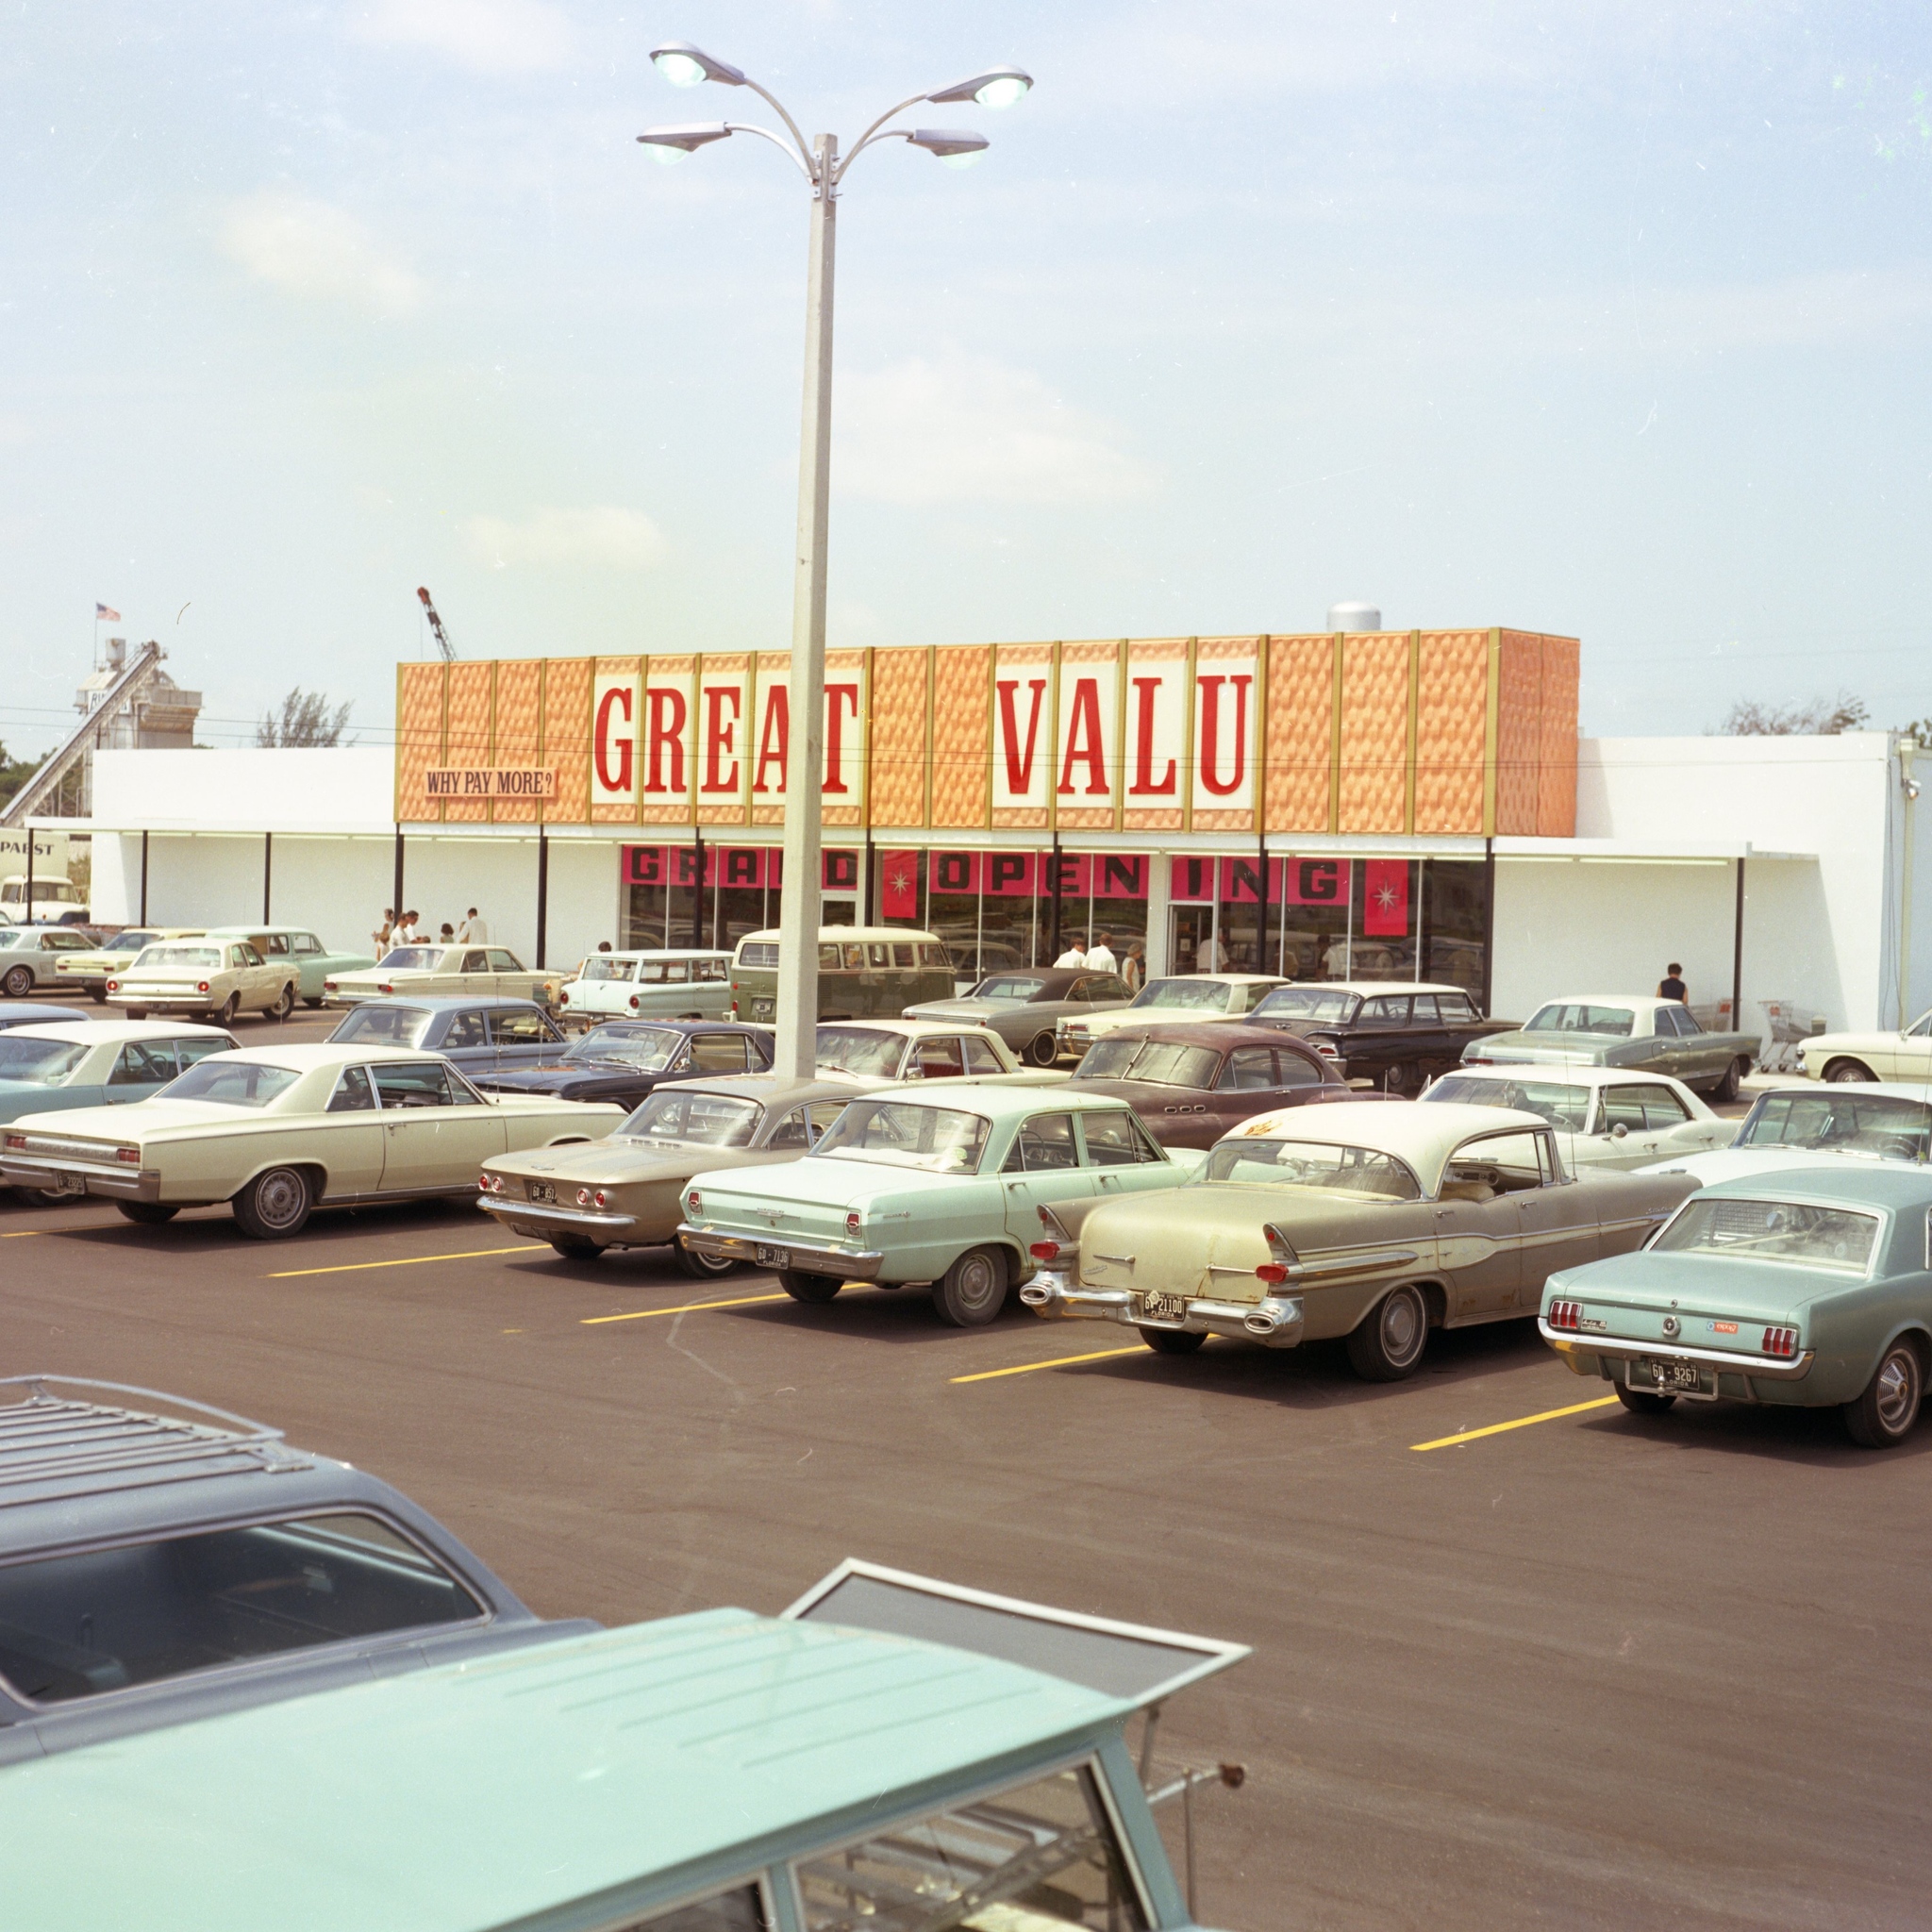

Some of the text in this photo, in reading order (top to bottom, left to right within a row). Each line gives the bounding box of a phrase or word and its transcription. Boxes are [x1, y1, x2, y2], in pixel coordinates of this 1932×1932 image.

[594, 675, 1253, 795] GREAT VALU
[426, 771, 552, 794] WHY PAY MORE?
[0, 841, 54, 856] PABST
[631, 847, 858, 887] GRAD
[1151, 1309, 1174, 1318] FLORIDA
